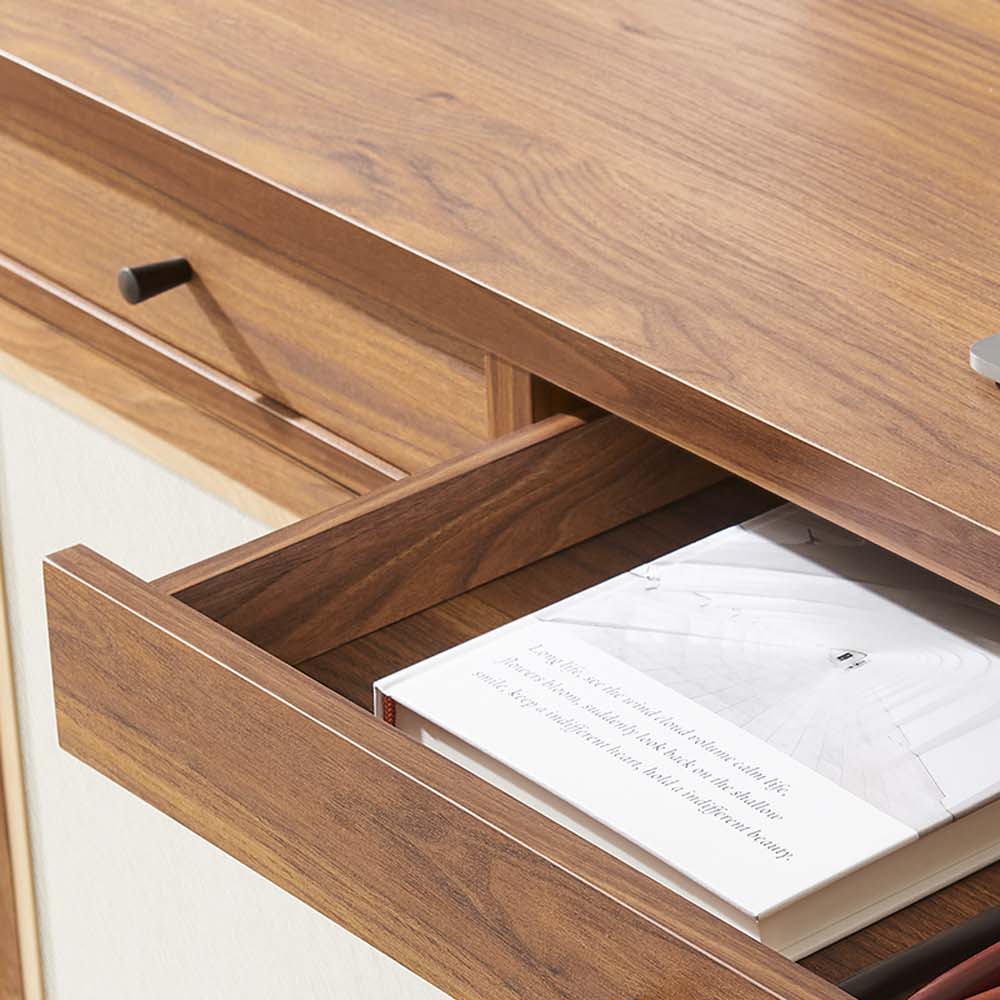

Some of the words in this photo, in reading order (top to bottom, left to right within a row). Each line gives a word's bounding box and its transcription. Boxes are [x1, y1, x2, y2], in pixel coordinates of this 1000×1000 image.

[495, 656, 545, 682] flowers
[581, 704, 639, 736] suddenly
[636, 733, 667, 751] look
[663, 748, 696, 768] back
[692, 768, 712, 779] on
[710, 777, 734, 791] the
[730, 791, 783, 819] shallow
[506, 689, 538, 708] keep
[545, 710, 611, 748] indifferent
[642, 767, 679, 786] hold
[681, 790, 751, 832] indifferent
[529, 644, 564, 665] Long
[583, 677, 609, 687] see
[602, 686, 627, 698] the
[622, 698, 662, 717] wind
[654, 717, 696, 736] cloud
[688, 735, 736, 762] volume
[733, 762, 766, 780] calm
